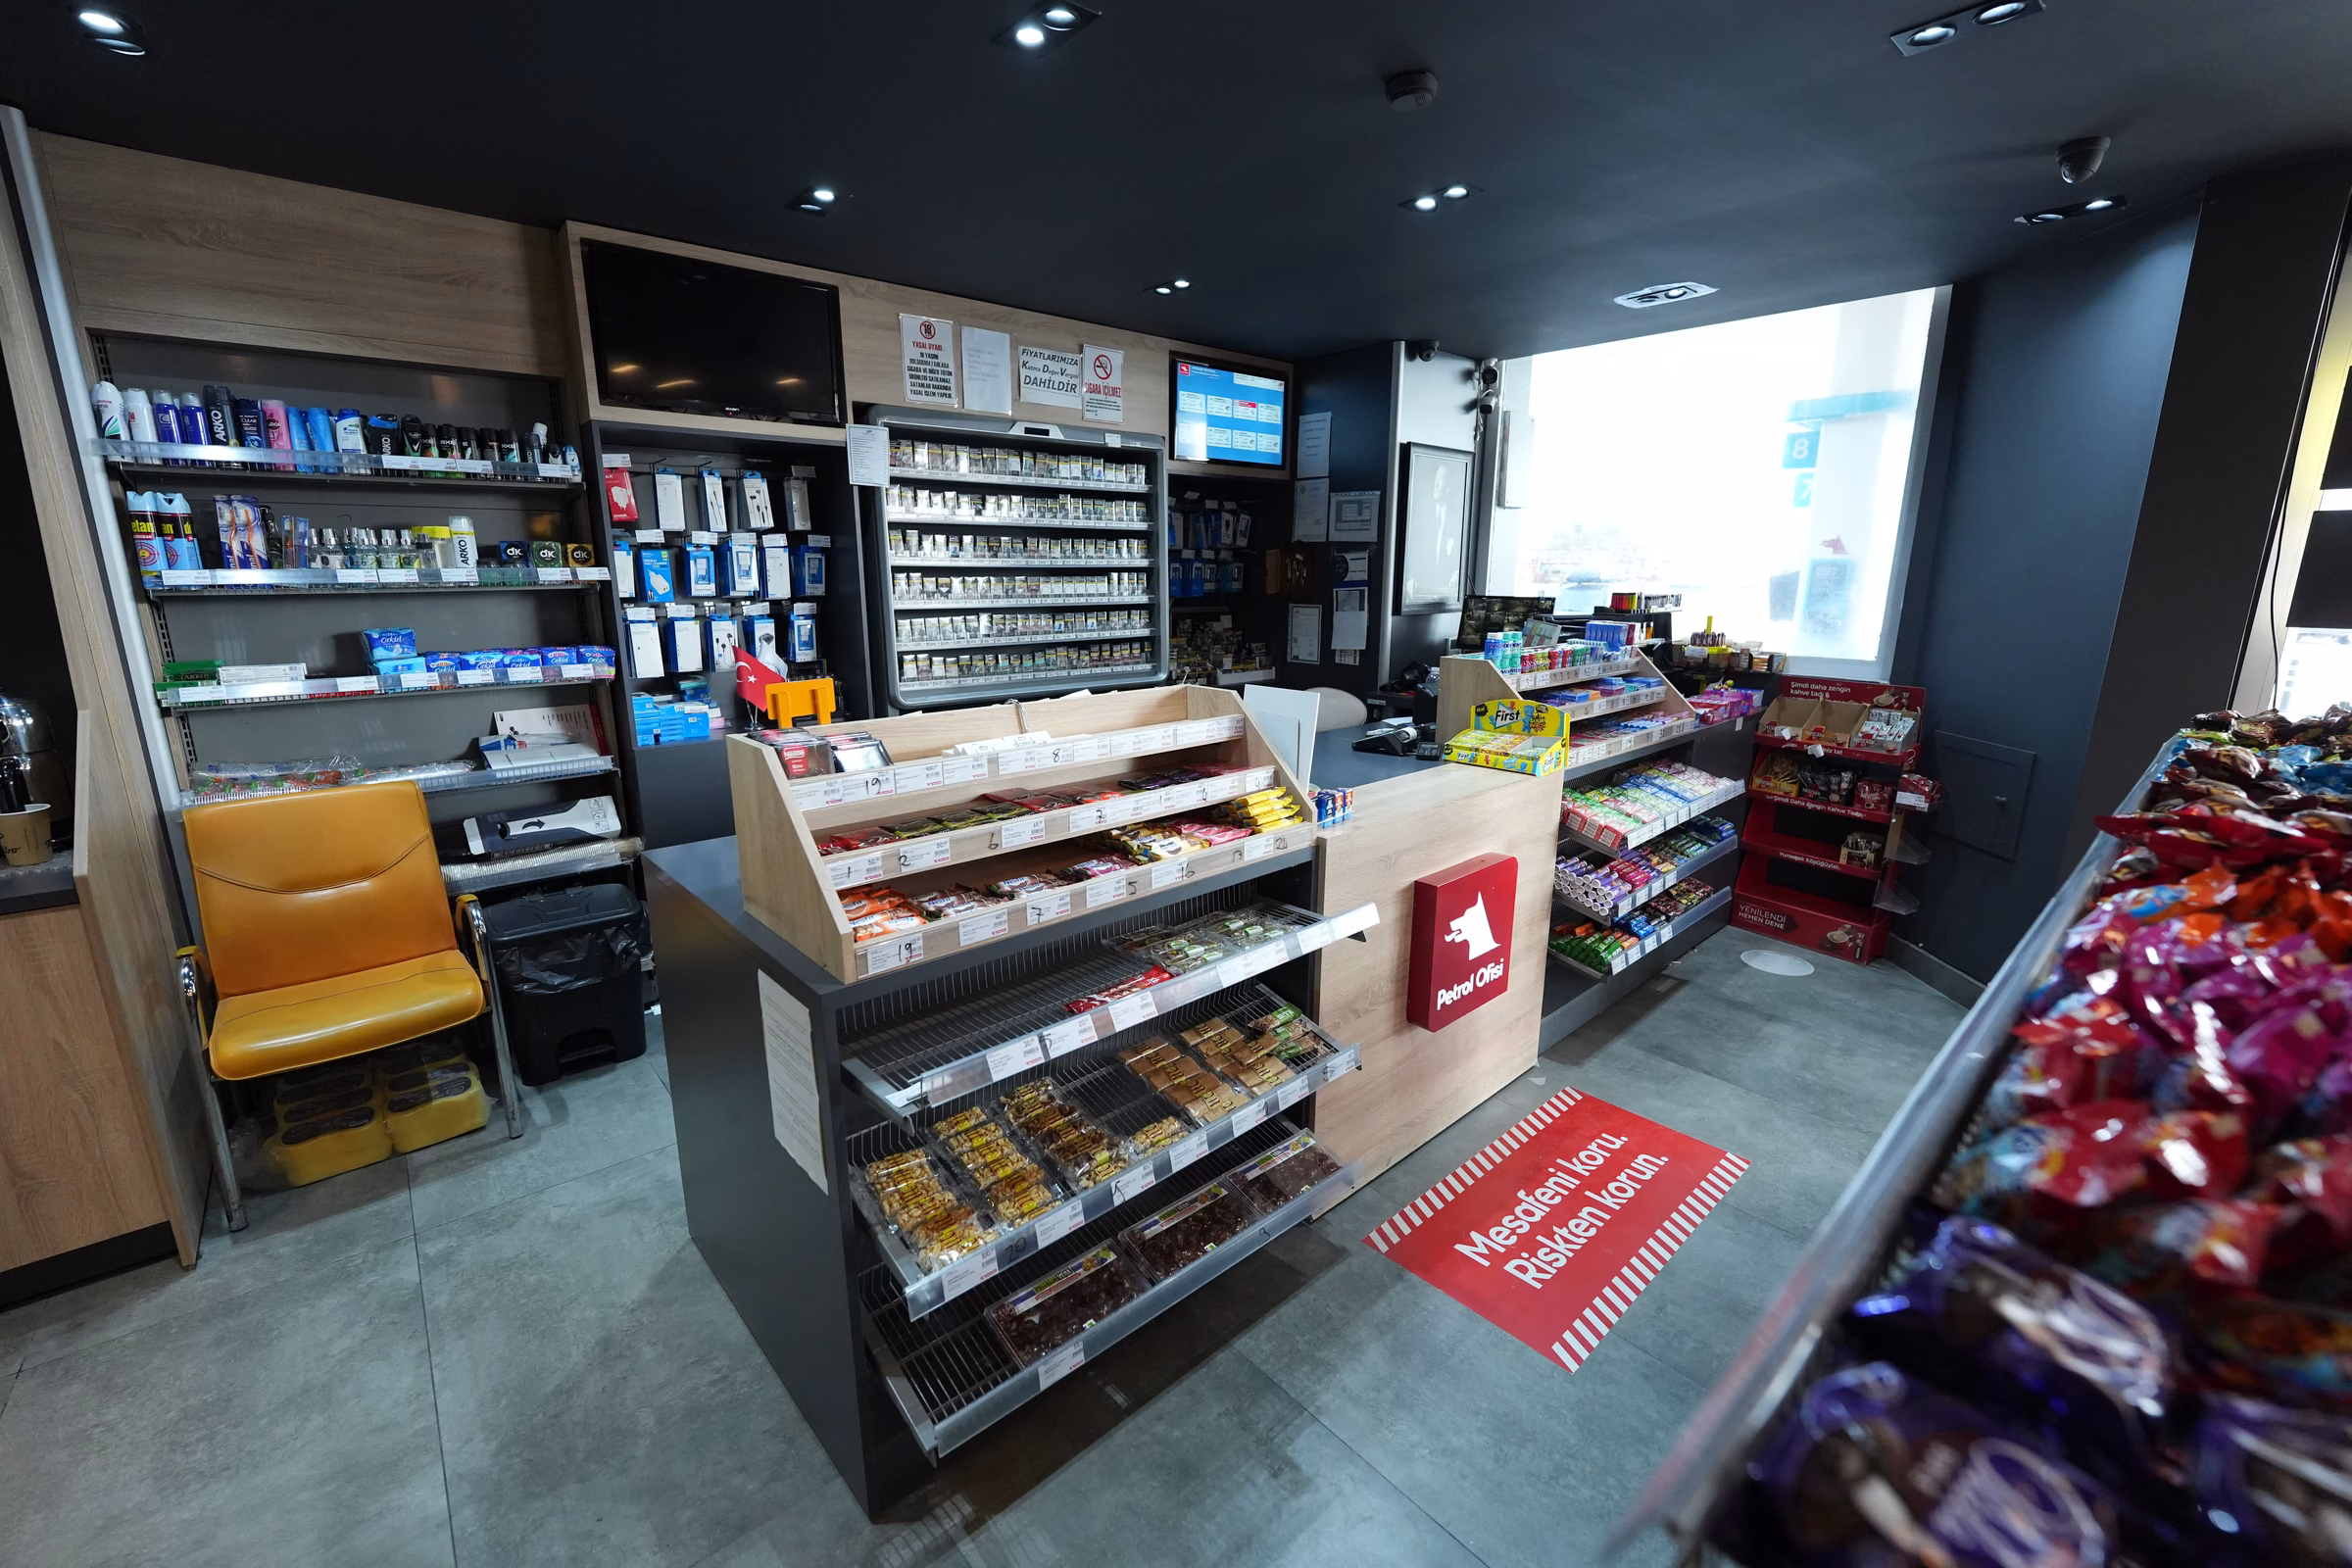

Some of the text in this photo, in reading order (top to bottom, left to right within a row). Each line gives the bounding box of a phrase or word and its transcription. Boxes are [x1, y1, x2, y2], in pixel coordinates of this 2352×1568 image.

[912, 341, 927, 350] YASAL
[1021, 348, 1079, 367] FİYATLARIMIZA
[1021, 360, 1079, 380] Katma Değer Vergisi
[1023, 374, 1078, 394] DAHİLDİR
[1102, 381, 1122, 400] İÇİLMEZ
[211, 410, 227, 442] ARKO
[1791, 437, 1810, 460] 8
[130, 519, 156, 533] etan
[458, 539, 470, 565] ARKO
[1790, 681, 1810, 690] Şimdi
[1811, 682, 1828, 691] daha
[1495, 710, 1521, 722] First
[899, 855, 911, 866] 2
[1739, 904, 1787, 923] YENİLENDİ
[1739, 911, 1786, 930] HEMEN DENE
[1437, 957, 1504, 1011] Petrol Ofisi
[1453, 1130, 1630, 1267] Mesafeni koru.
[1502, 1152, 1670, 1290] Riskten korun.
